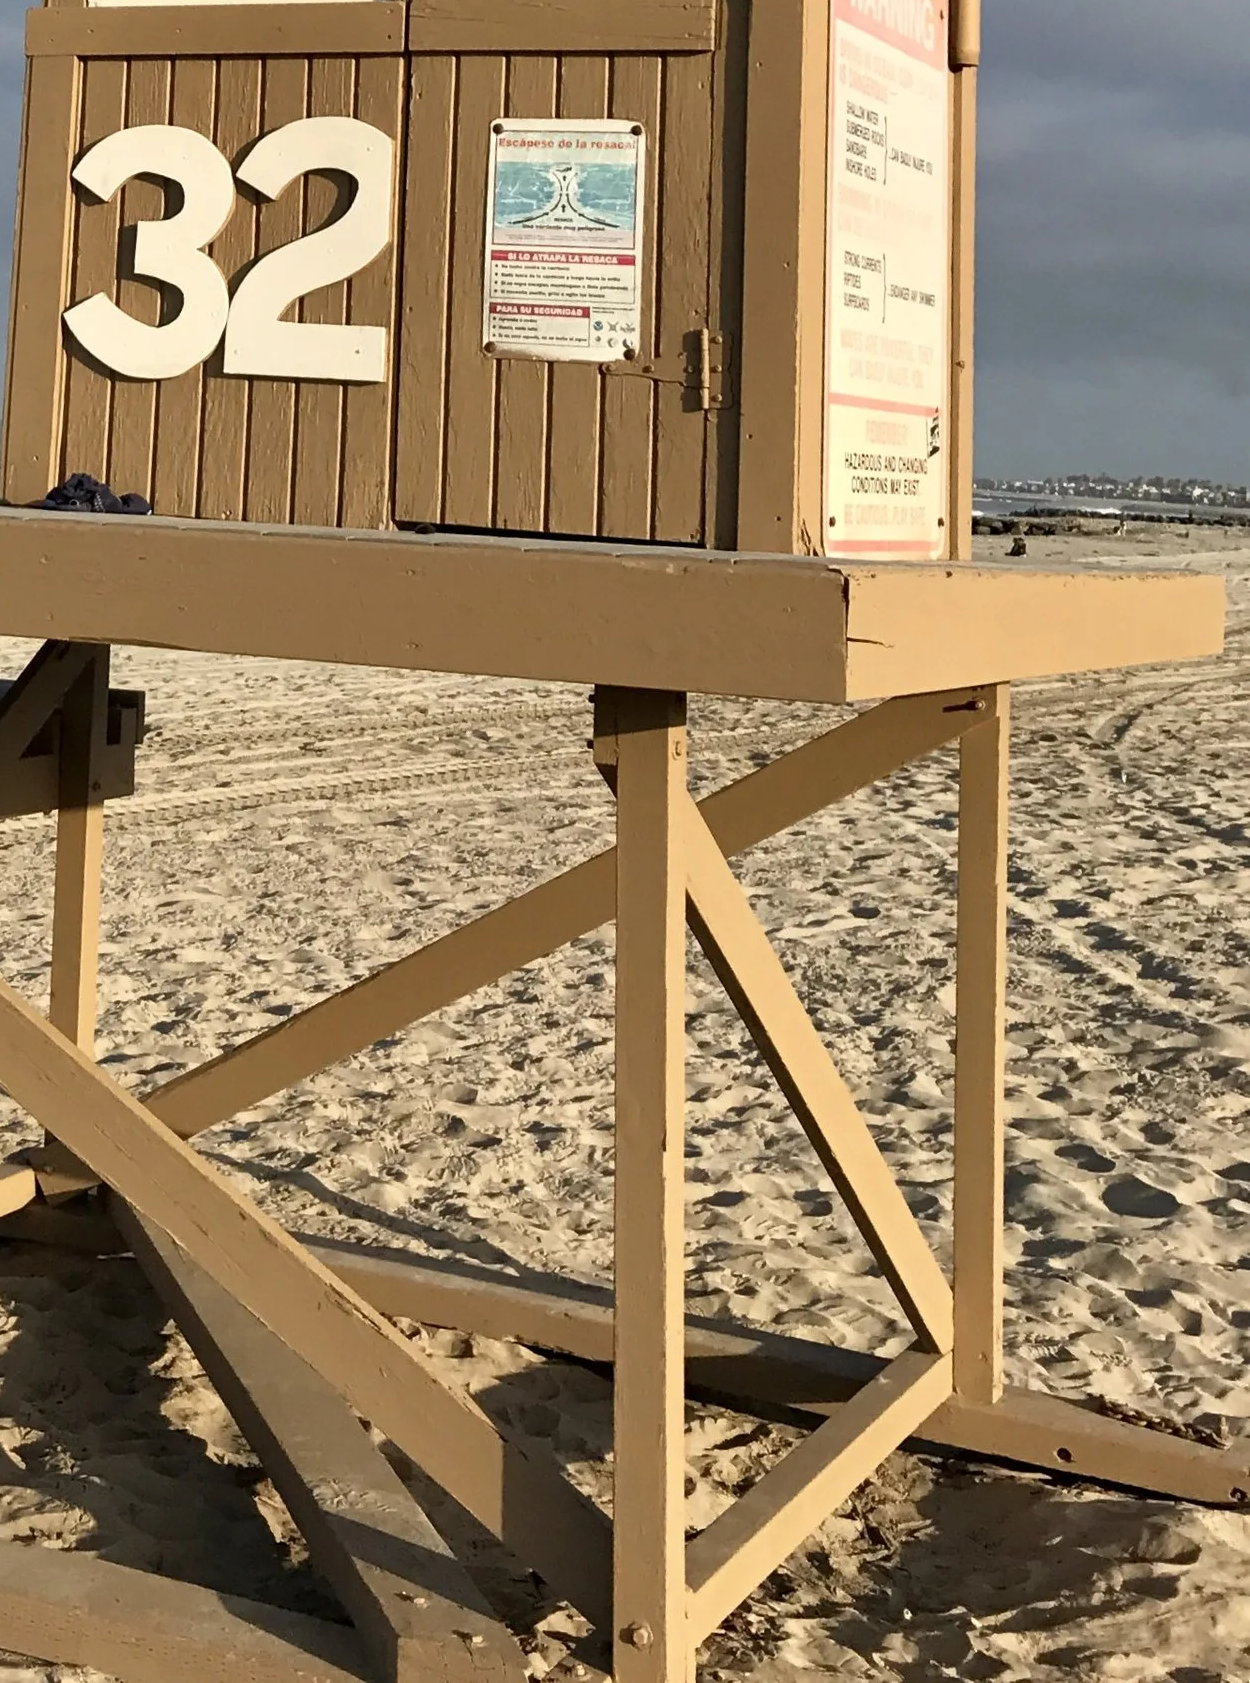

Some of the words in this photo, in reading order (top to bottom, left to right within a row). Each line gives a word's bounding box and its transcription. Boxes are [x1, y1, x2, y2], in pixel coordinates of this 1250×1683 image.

[498, 137, 554, 151] Escápese
[558, 138, 572, 150] de
[576, 138, 587, 150] la
[61, 115, 394, 382] 32
[507, 252, 516, 260] SI
[518, 253, 530, 261] LO
[532, 254, 566, 262] ATRAPA
[582, 255, 618, 264] RESACA
[496, 304, 518, 314] PARA
[520, 306, 532, 314] SU
[533, 307, 583, 317] SEGURIDAD
[844, 451, 882, 472] HAZARDOUS
[884, 455, 896, 473] AND
[898, 456, 928, 475] CHANGING
[851, 475, 888, 494] CONDITIONS
[890, 478, 901, 495] MAY
